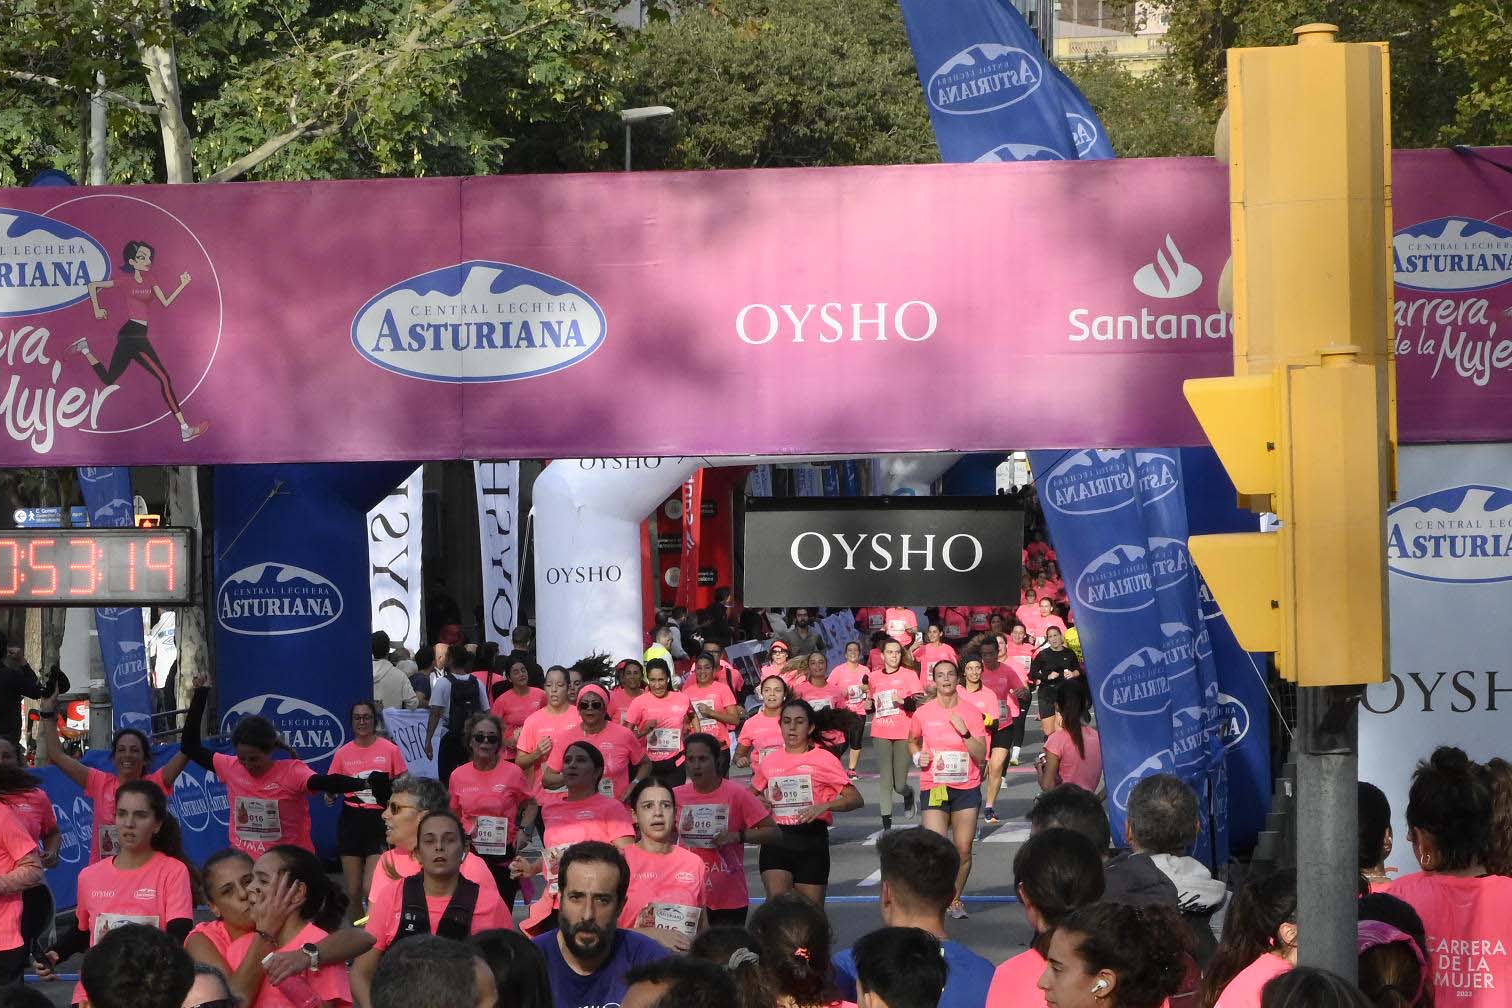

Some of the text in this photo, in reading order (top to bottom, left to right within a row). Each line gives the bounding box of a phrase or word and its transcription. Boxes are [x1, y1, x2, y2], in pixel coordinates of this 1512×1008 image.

[13, 245, 86, 256] LECHERA
[410, 301, 578, 317] CENTRAL LECHERA
[1394, 298, 1489, 327] arrera
[371, 308, 587, 353] ASTURIANA
[735, 300, 938, 344] OYSHO
[1068, 307, 1234, 342] Santand
[1417, 322, 1512, 387] la Muje
[1415, 520, 1482, 530] CENTRAL
[790, 532, 983, 572] OYSHO
[546, 565, 622, 585] OYSHO
[280, 586, 330, 596] LECHERA
[221, 591, 334, 620] ASTURIANA
[249, 814, 264, 823] 016
[478, 830, 492, 838] 016
[1439, 954, 1491, 972] DE LA
[1433, 972, 1495, 988] MUJER
